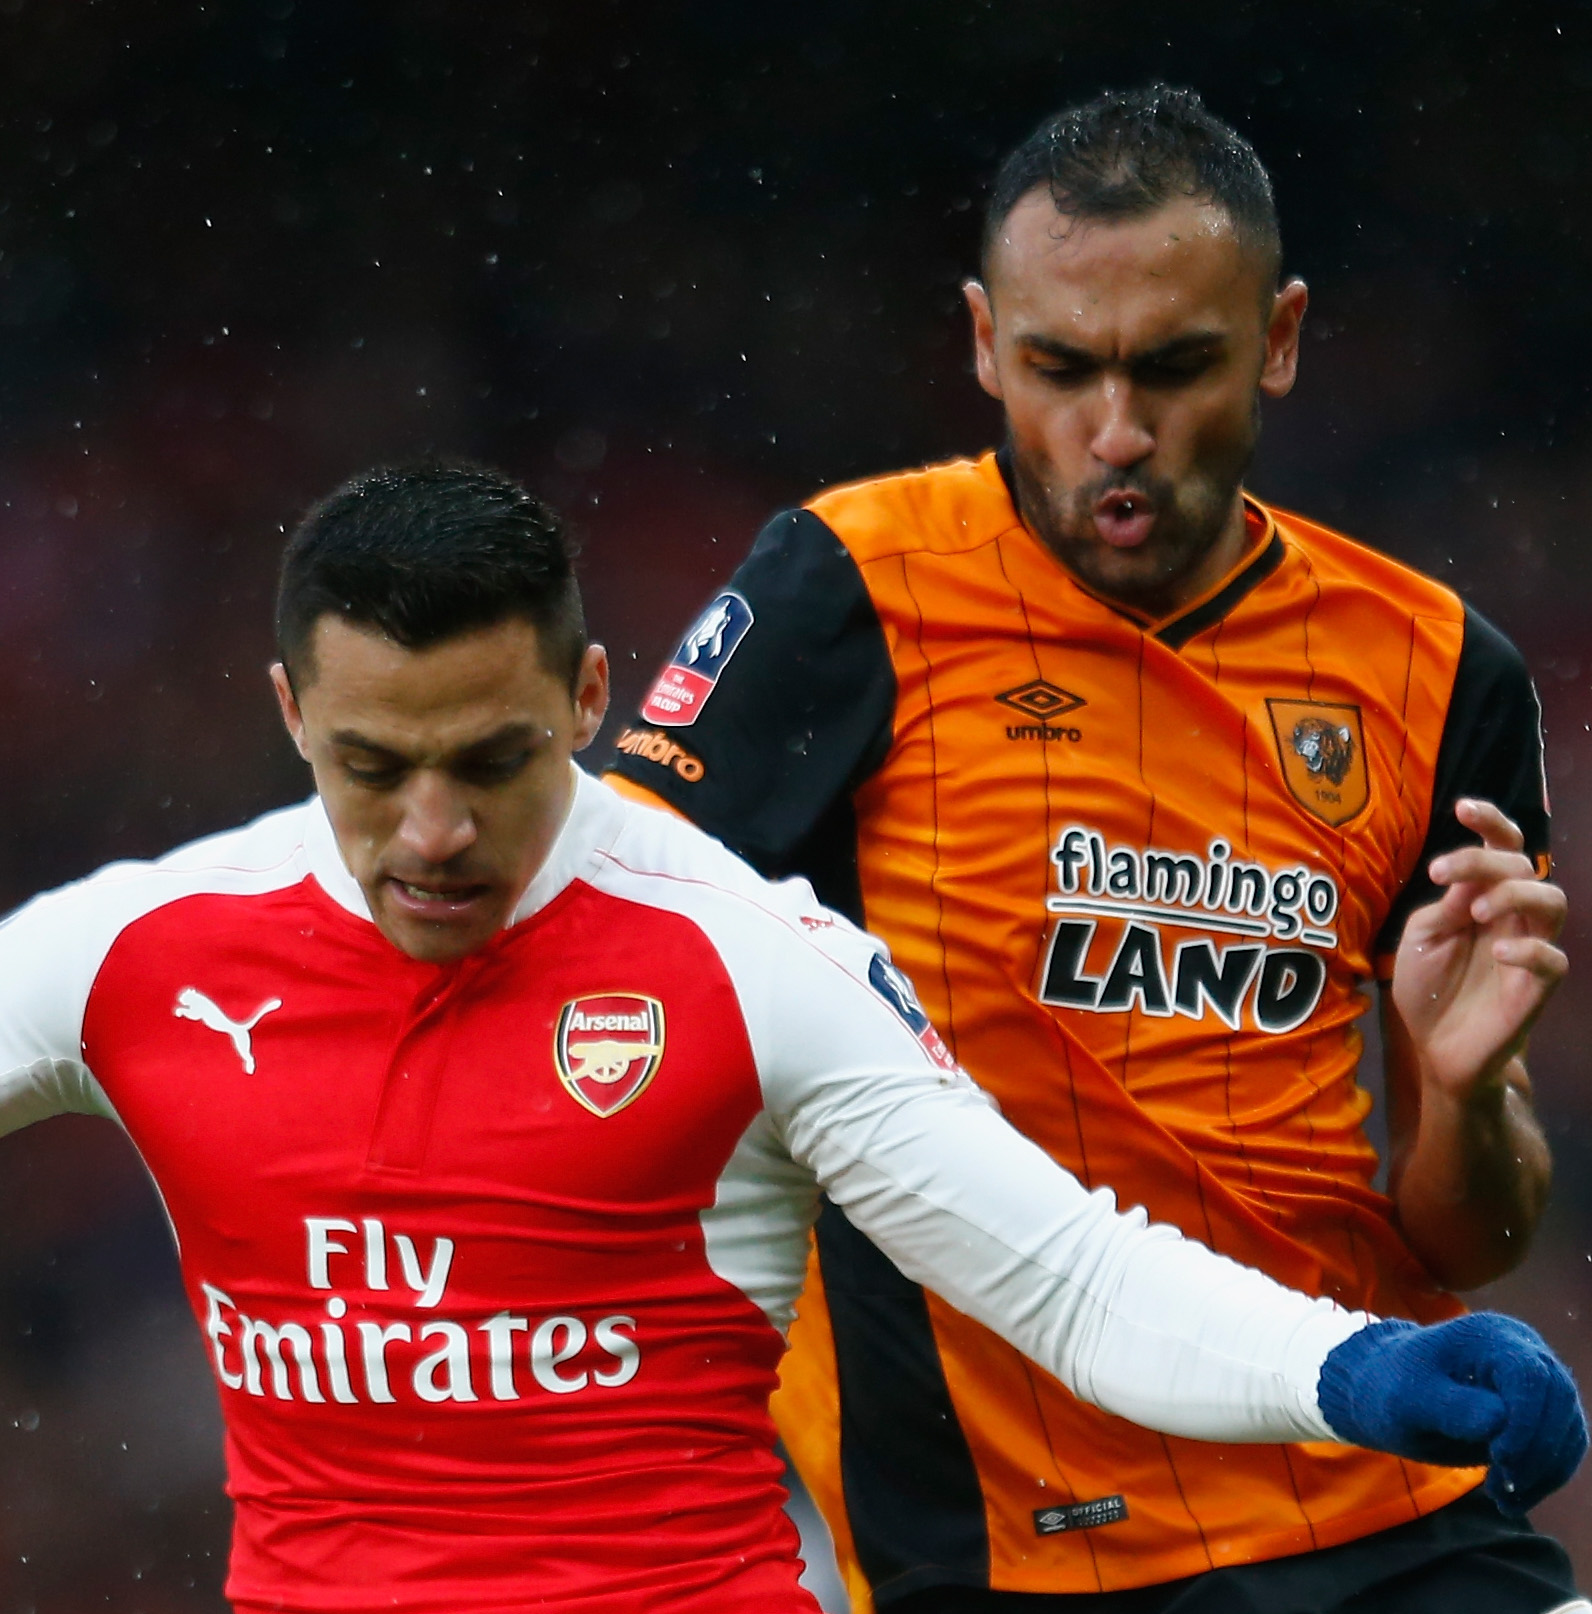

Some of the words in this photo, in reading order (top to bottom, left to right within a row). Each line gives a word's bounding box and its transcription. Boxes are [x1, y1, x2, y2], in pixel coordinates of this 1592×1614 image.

[1005, 723, 1083, 743] umbro
[1051, 826, 1338, 940] flamingo
[569, 1011, 648, 1032] Arsenal
[1039, 918, 1327, 1035] LAND
[304, 1218, 455, 1308] Fly
[202, 1283, 642, 1404] Emirates
